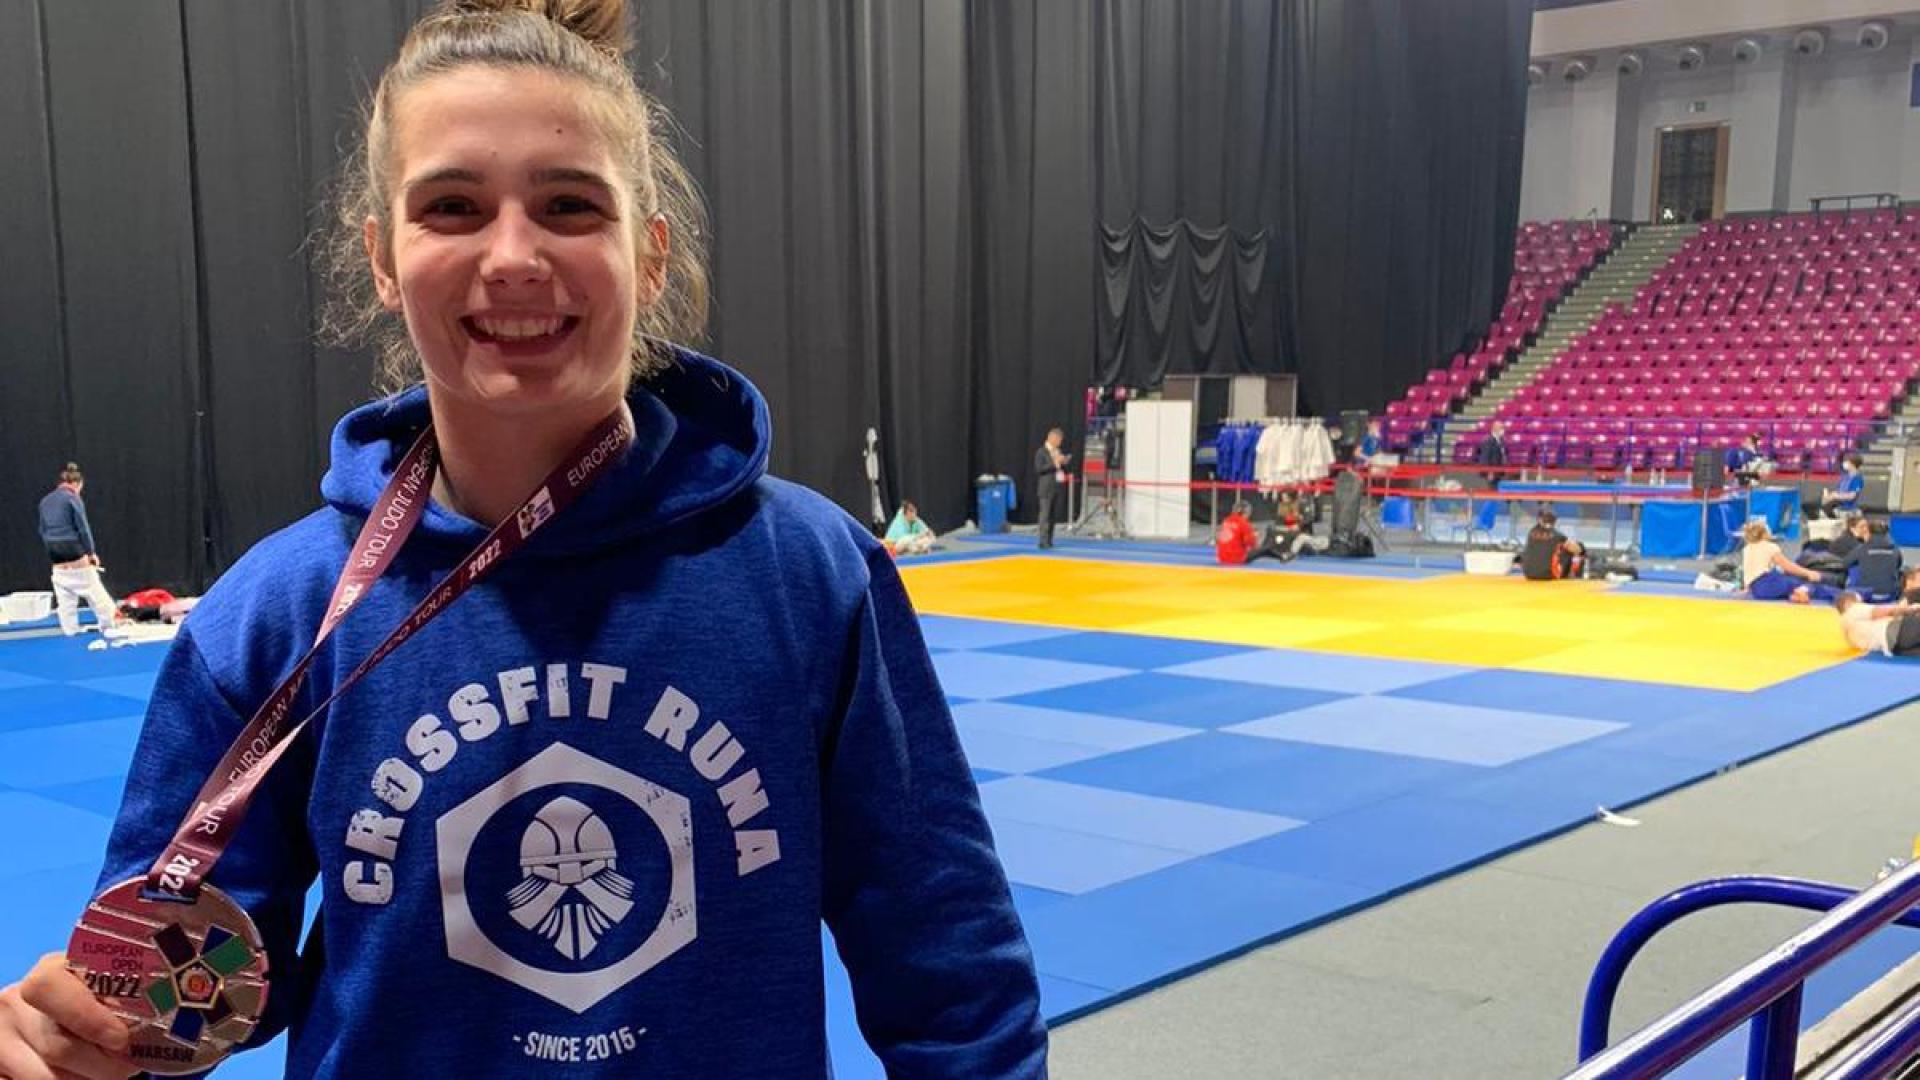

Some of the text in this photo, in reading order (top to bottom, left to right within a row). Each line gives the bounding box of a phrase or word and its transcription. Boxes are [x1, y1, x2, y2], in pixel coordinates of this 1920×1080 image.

[381, 489, 413, 530] JUDO
[358, 531, 393, 569] TOUR
[343, 663, 782, 905] CROSSFIT RUNA
[159, 852, 201, 896] 202
[524, 1026, 636, 1062] SINCE 2015
